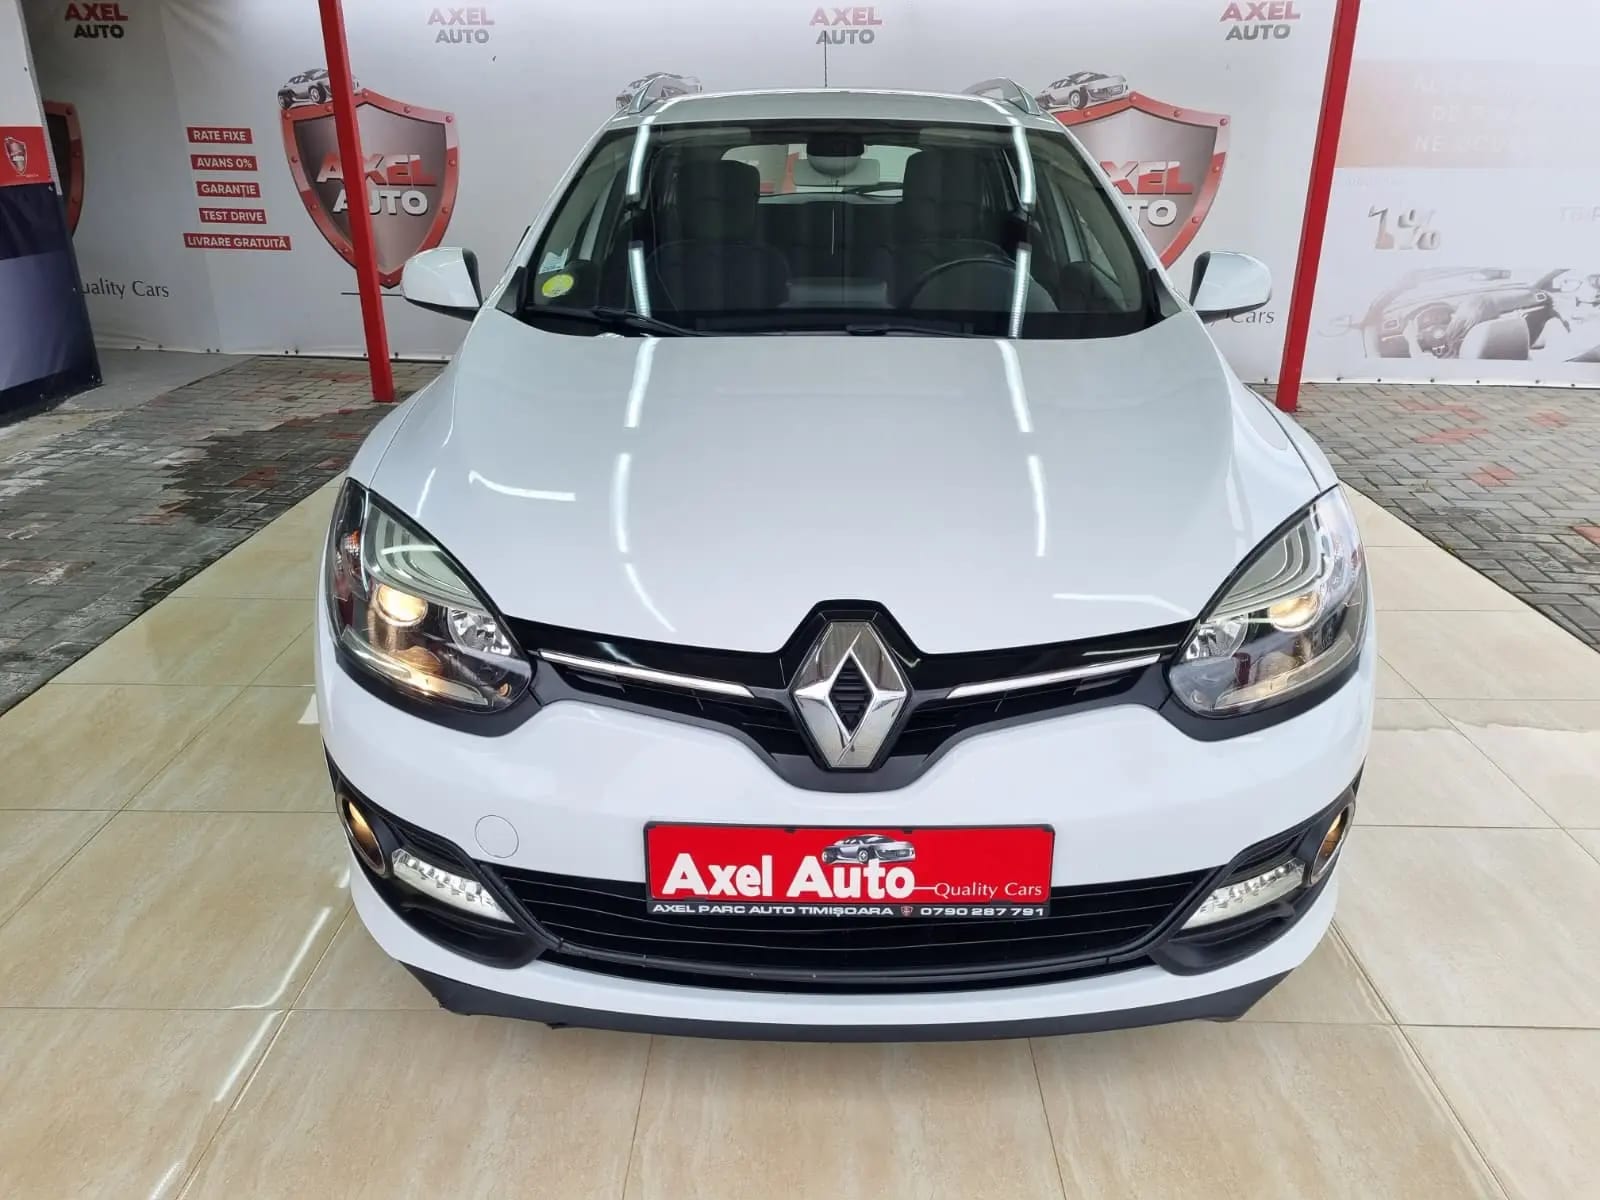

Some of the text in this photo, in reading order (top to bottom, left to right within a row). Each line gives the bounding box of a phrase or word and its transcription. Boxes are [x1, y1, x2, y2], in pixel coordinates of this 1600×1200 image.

[64, 2, 129, 22] AXEL
[427, 7, 495, 26] AXEL
[810, 6, 883, 26] AXEL
[1220, 1, 1301, 21] AXEL
[74, 23, 125, 39] AUTO
[435, 28, 490, 44] AUTO
[816, 29, 875, 45] AUTO
[1225, 24, 1291, 41] AUTO
[193, 130, 246, 141] RATE FIXE
[197, 157, 252, 169] AVANS 0%
[1099, 160, 1195, 196] XEL
[202, 210, 263, 222] TEST DRIVE
[187, 236, 287, 249] LIVRARE GRATUITĂ
[81, 277, 169, 300] uality Cars
[661, 852, 1043, 900] Axel Auto Quality Cars
[652, 904, 696, 914] AXEL
[699, 905, 746, 915] PARC
[748, 905, 796, 915] AUTO
[920, 907, 968, 917] 0790
